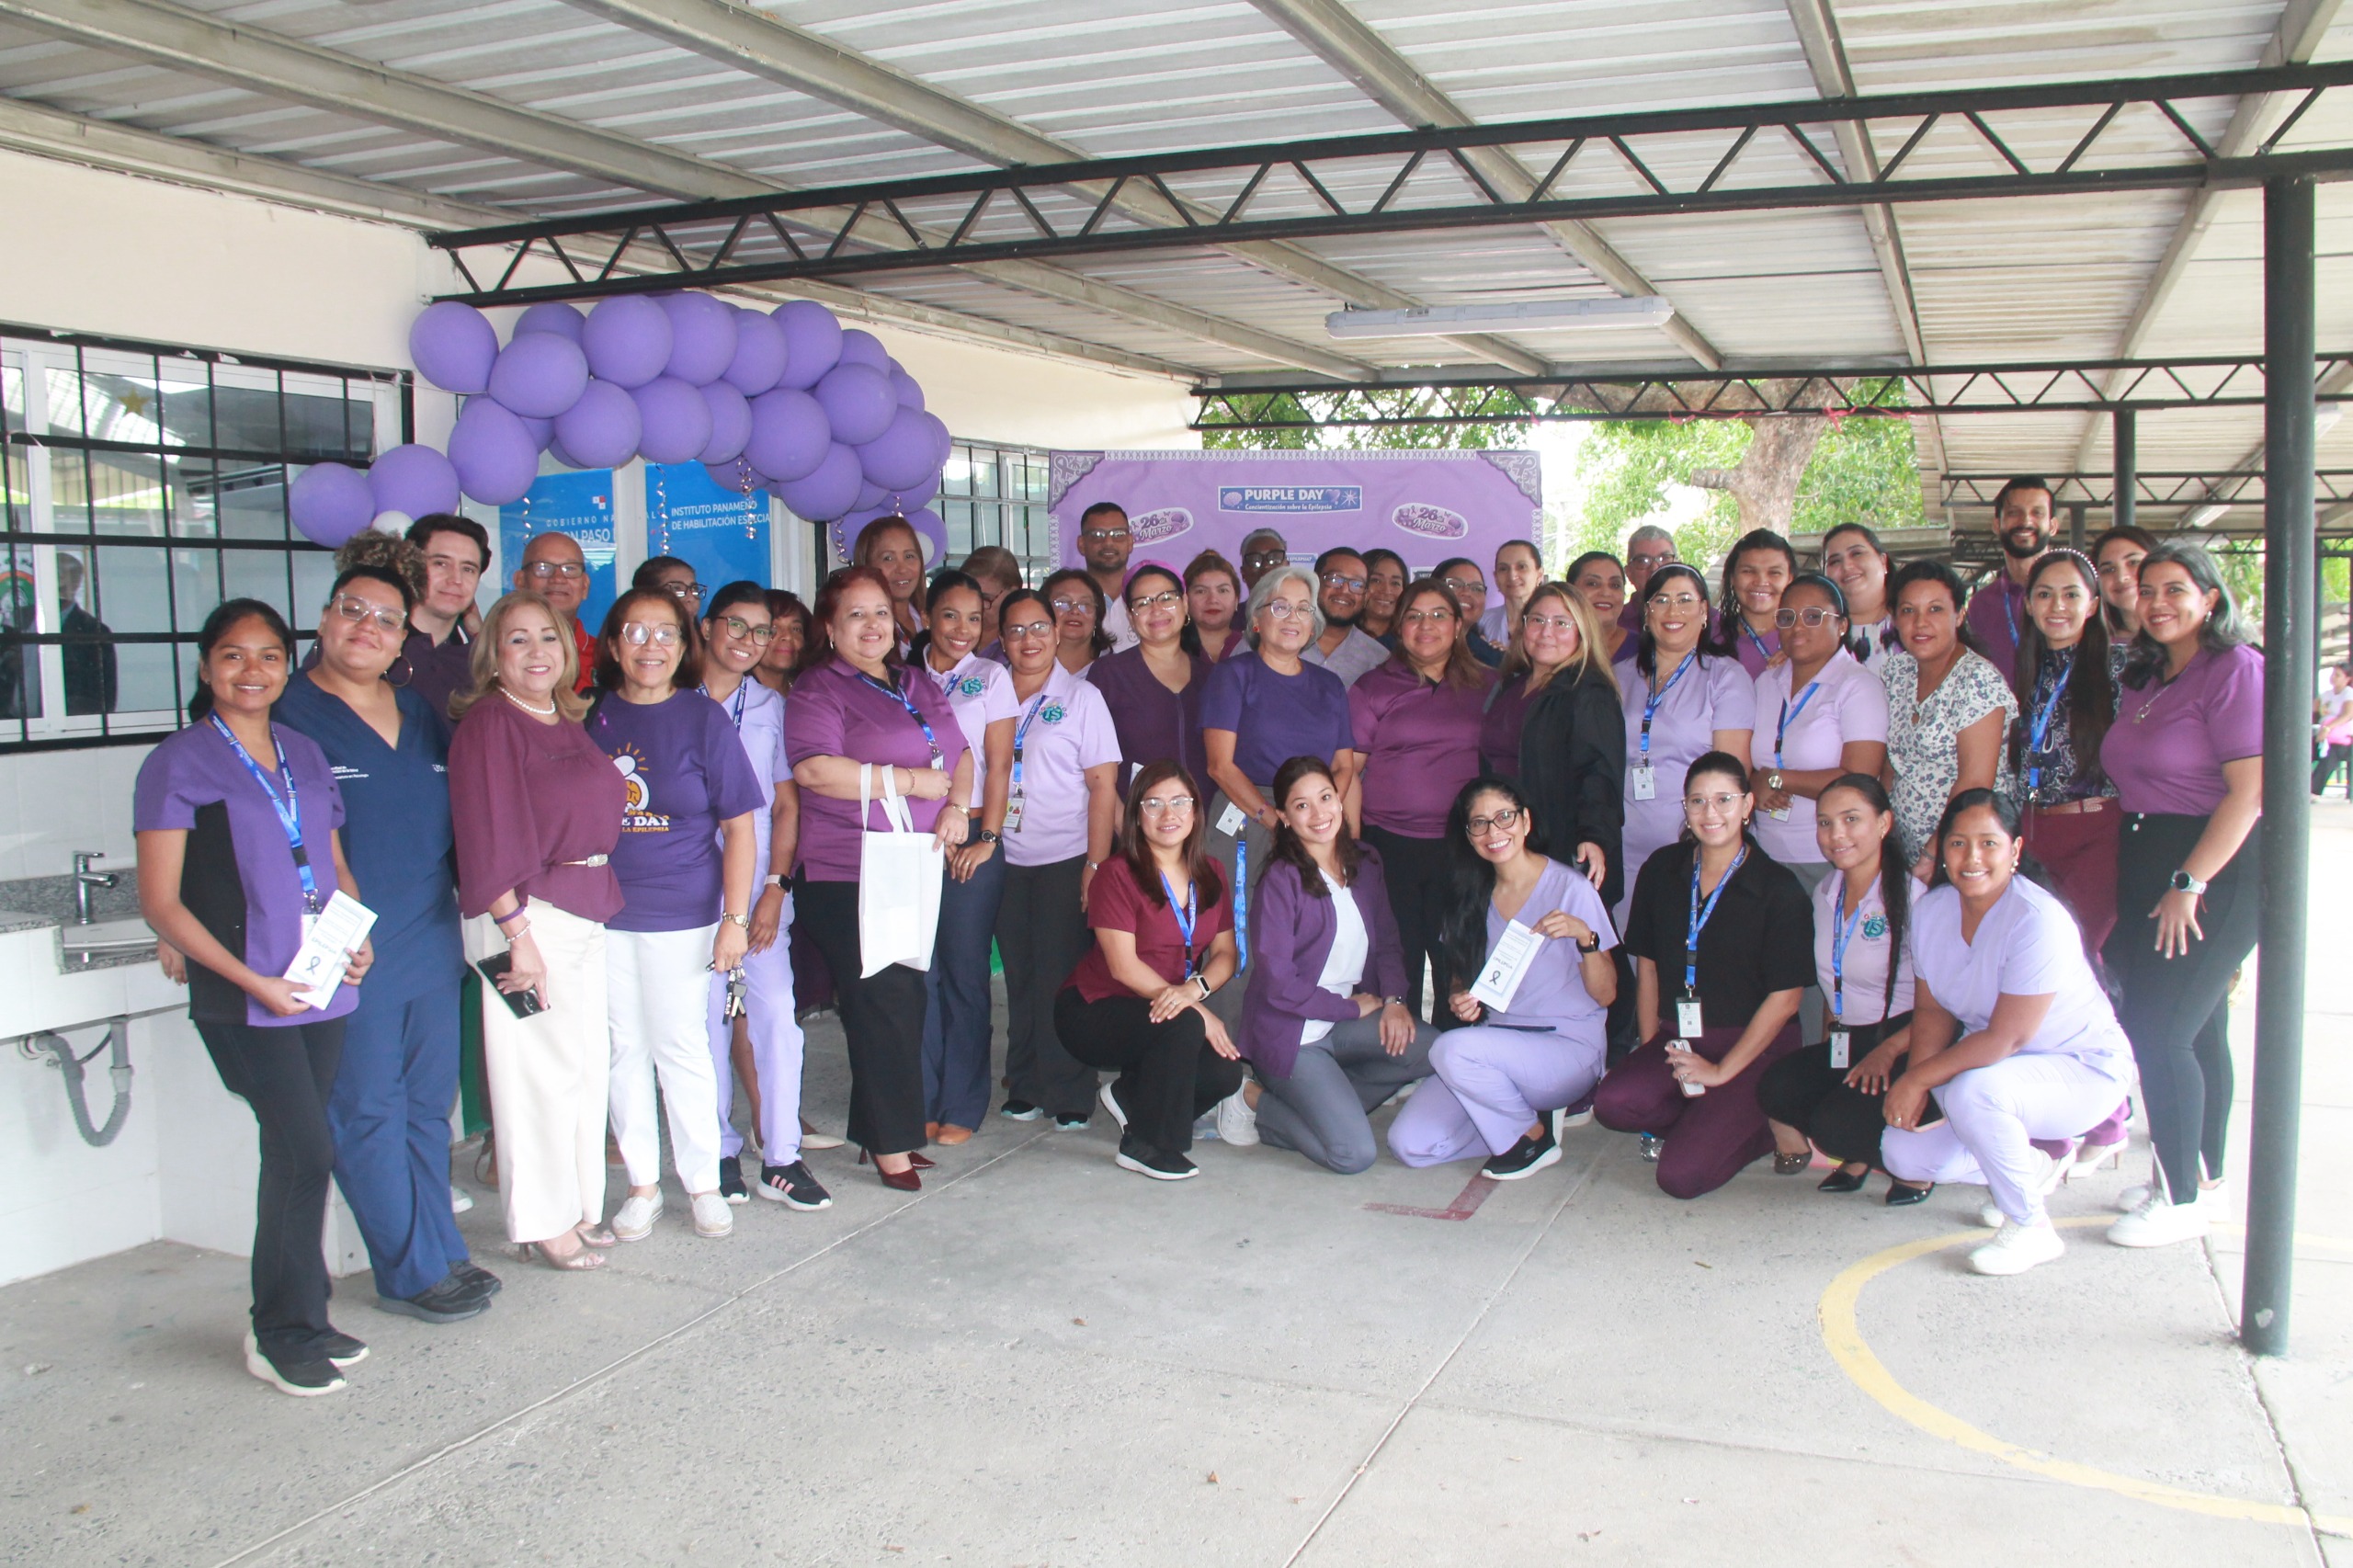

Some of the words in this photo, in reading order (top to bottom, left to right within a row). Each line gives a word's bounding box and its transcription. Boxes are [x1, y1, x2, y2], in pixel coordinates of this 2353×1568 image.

[1245, 489, 1295, 501] PURPLE
[1298, 489, 1324, 501] DAY
[671, 505, 712, 517] INSTITUTO
[1308, 503, 1333, 512] Epilepsia
[1417, 506, 1438, 521] 26
[546, 515, 597, 528] GOBIERNO
[672, 520, 682, 530] DE
[683, 515, 736, 529] HABILITACIÓN
[737, 513, 770, 525] ESPECIA
[1140, 513, 1160, 529] 26
[1413, 517, 1447, 533] Marzo
[581, 528, 610, 543] PASO
[1139, 525, 1174, 541] Marzo
[634, 815, 670, 826] DAY
